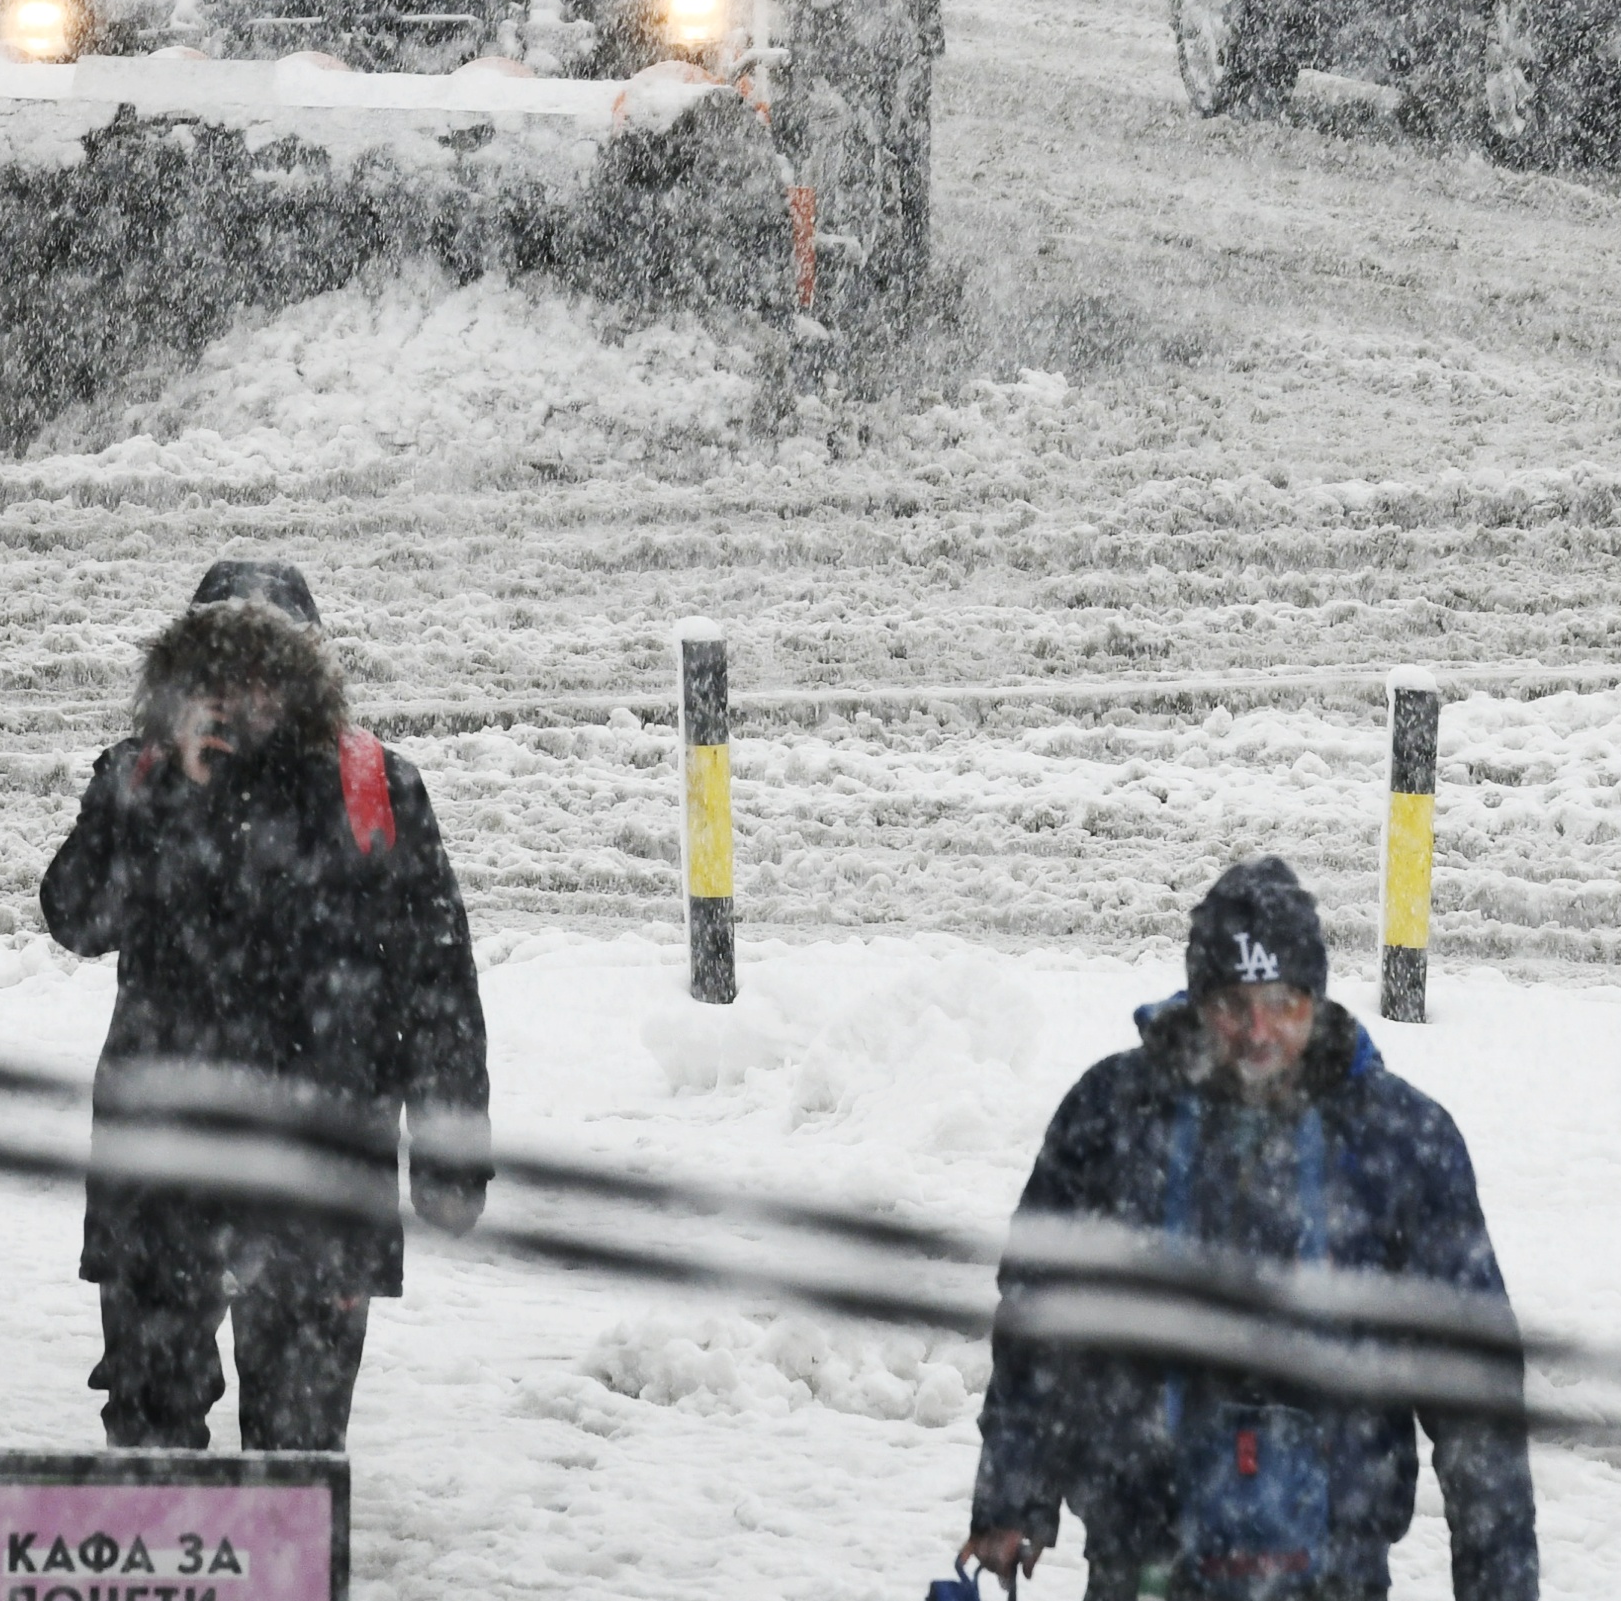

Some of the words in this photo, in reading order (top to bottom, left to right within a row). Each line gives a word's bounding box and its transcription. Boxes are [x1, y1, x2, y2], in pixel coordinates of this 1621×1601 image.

[1232, 932, 1280, 982] LA
[7, 1530, 155, 1575] КАФА
[177, 1532, 243, 1576] ЗА
